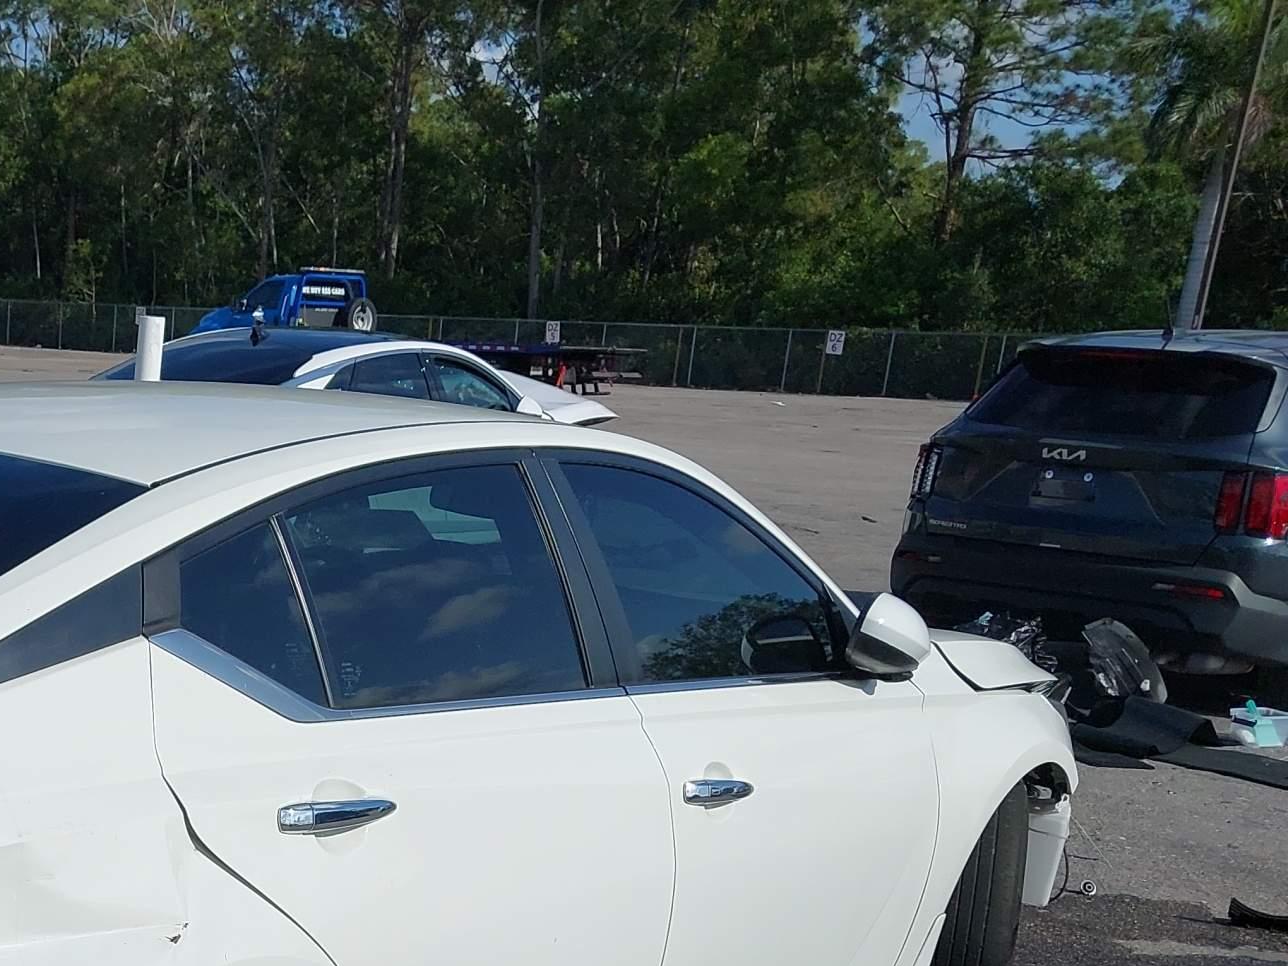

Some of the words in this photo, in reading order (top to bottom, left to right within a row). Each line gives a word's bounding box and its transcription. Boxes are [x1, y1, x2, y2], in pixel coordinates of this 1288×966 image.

[548, 323, 559, 332] DZ
[829, 333, 843, 343] DZ
[831, 343, 837, 352] 6
[1042, 447, 1086, 461] KIA
